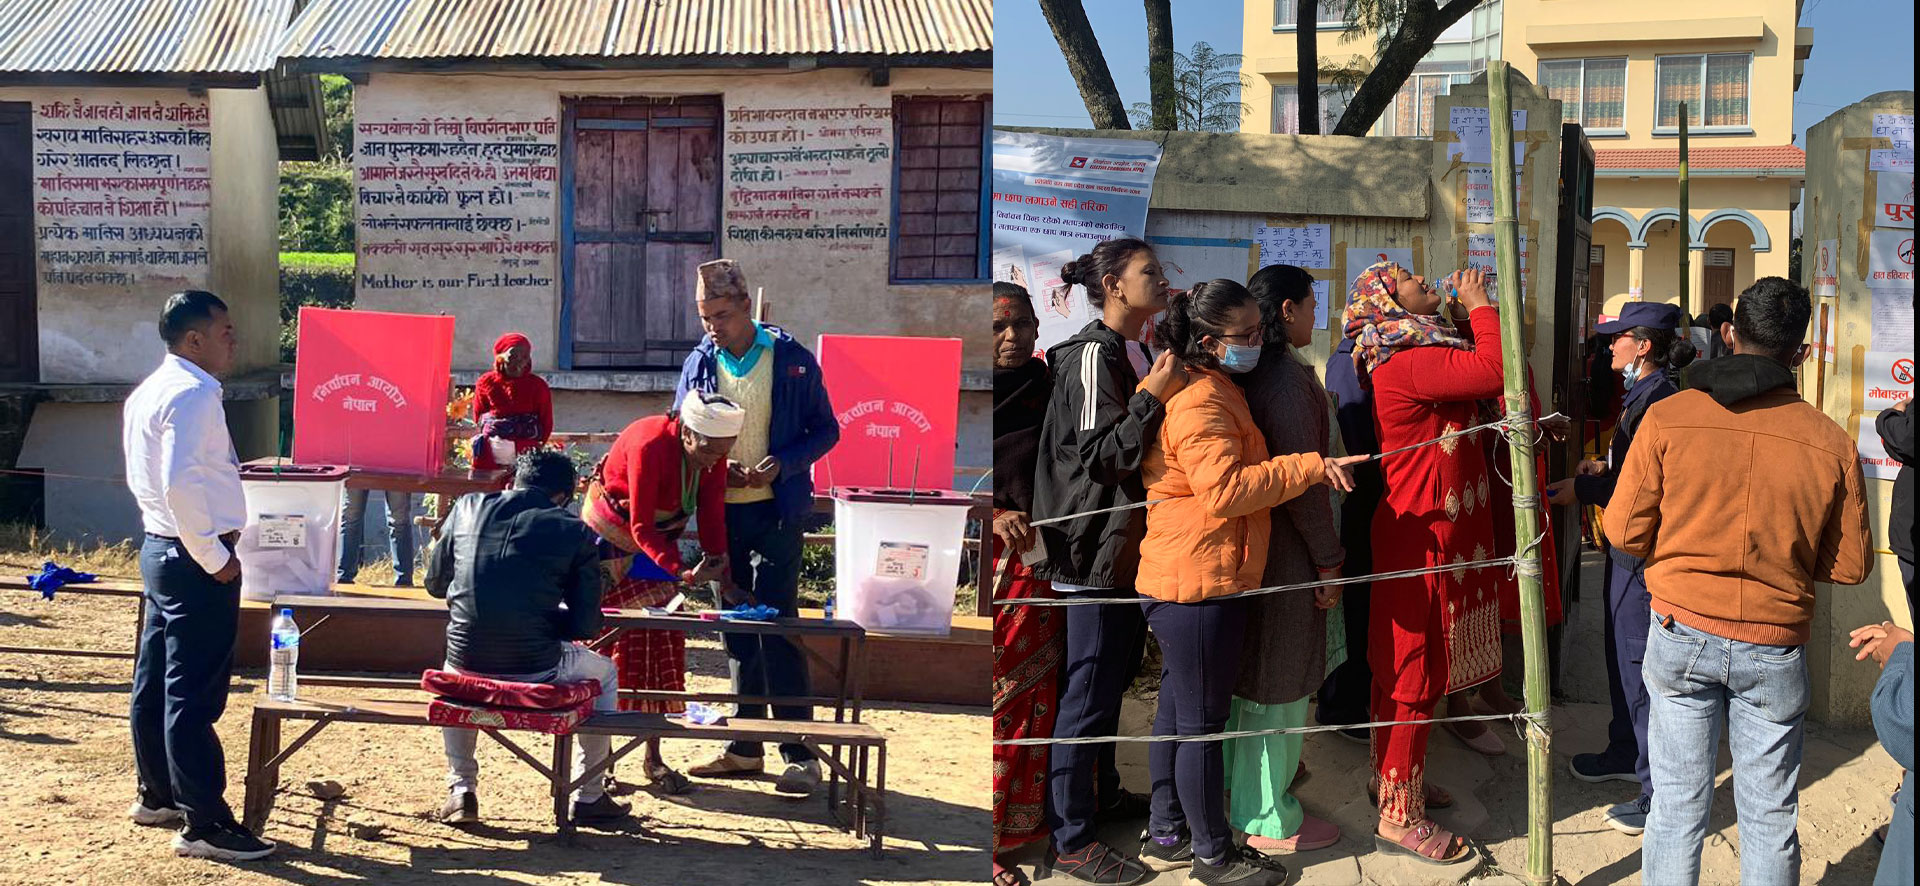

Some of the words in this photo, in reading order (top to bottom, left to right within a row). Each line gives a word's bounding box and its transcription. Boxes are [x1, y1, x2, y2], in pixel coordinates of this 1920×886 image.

[1004, 192, 1023, 204] छाप
[1025, 195, 1057, 208] लगाउने
[1060, 197, 1078, 210] सही
[1080, 201, 1108, 213] तरिका
[1272, 227, 1285, 236] आ
[361, 273, 418, 290] Mother
[422, 274, 435, 289] is
[438, 276, 464, 288] our
[502, 273, 553, 288] teacher
[366, 375, 408, 409] आयोग
[1868, 386, 1909, 401] मोबाइल
[343, 396, 378, 413] नेपाल
[890, 401, 932, 434] आयोग
[865, 422, 901, 439] नेपाल
